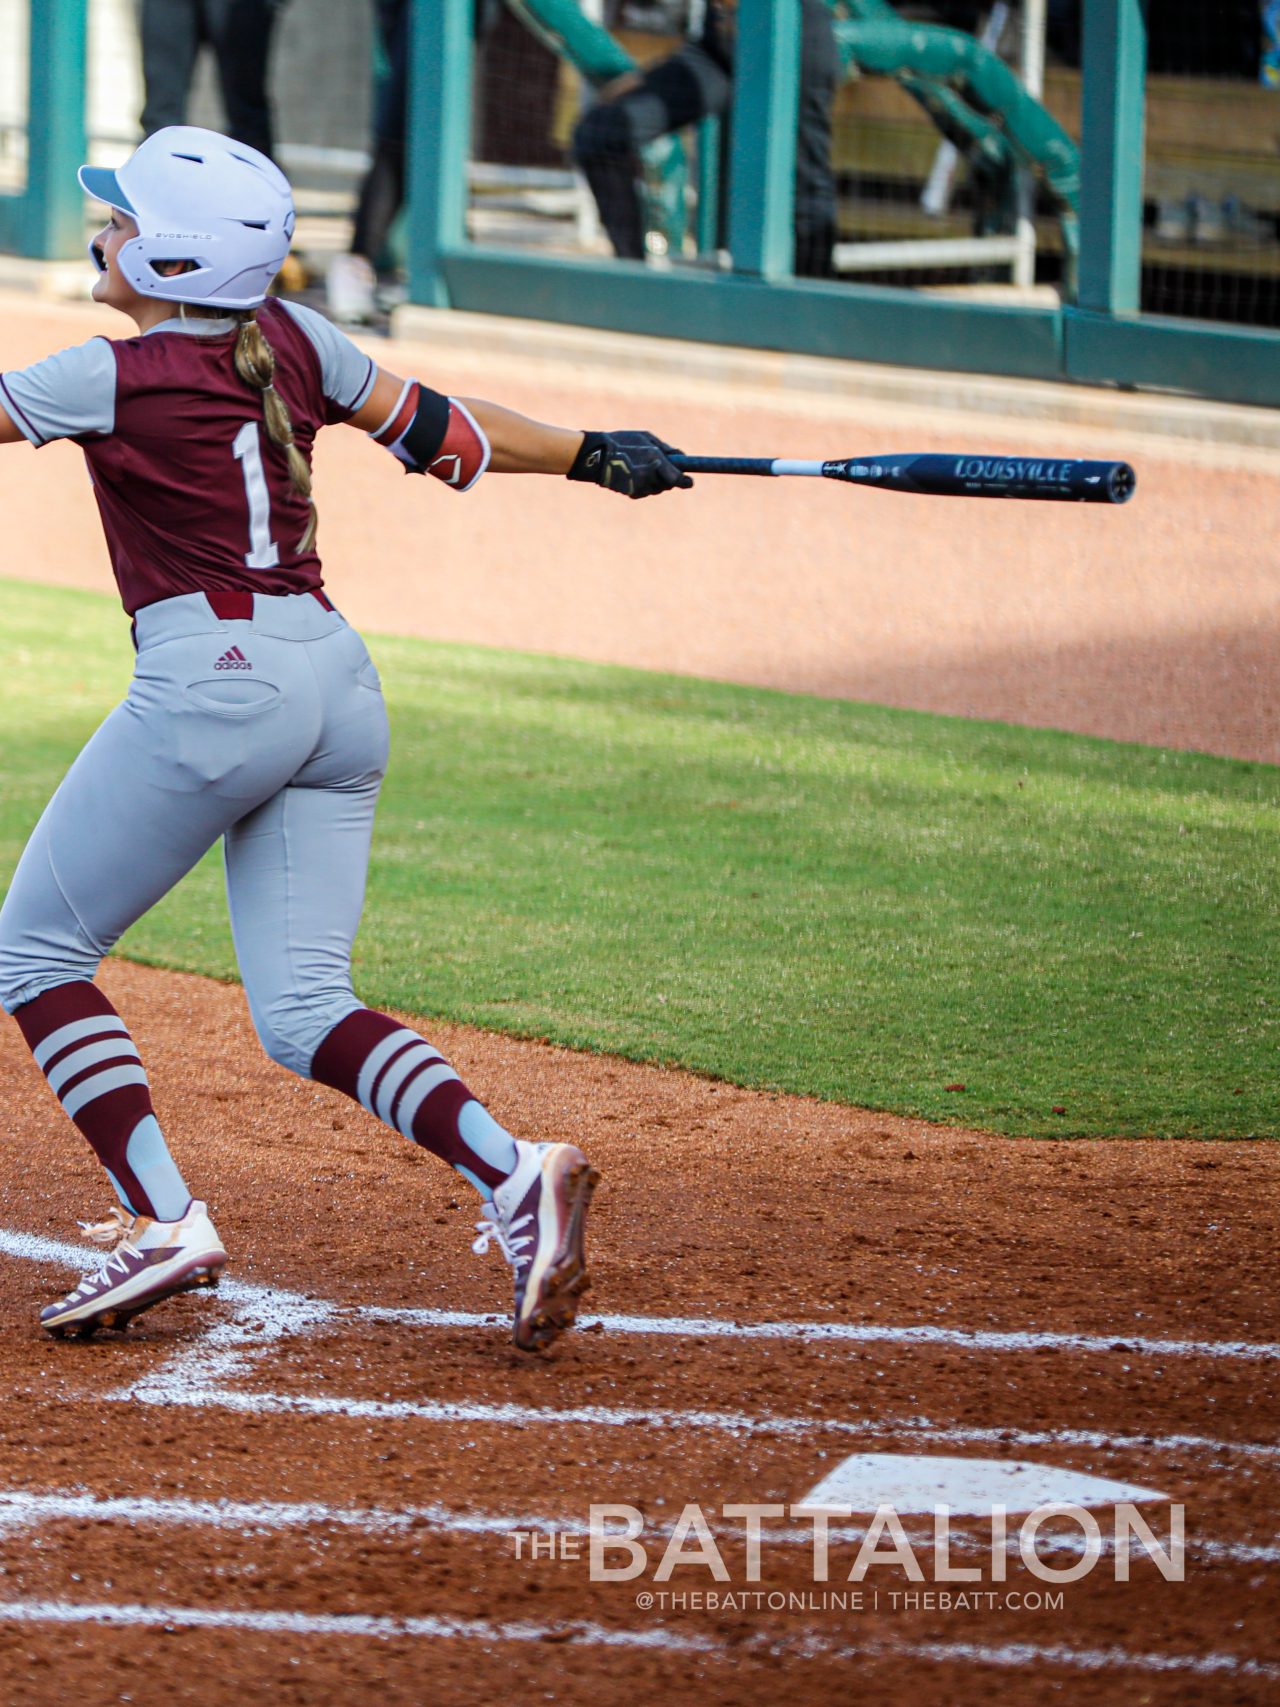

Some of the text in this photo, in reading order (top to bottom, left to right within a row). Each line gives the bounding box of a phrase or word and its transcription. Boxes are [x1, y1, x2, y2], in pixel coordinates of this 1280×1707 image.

[954, 459, 1072, 482] LOUISVILLE
[232, 421, 280, 569] 1
[214, 661, 252, 670] adidas
